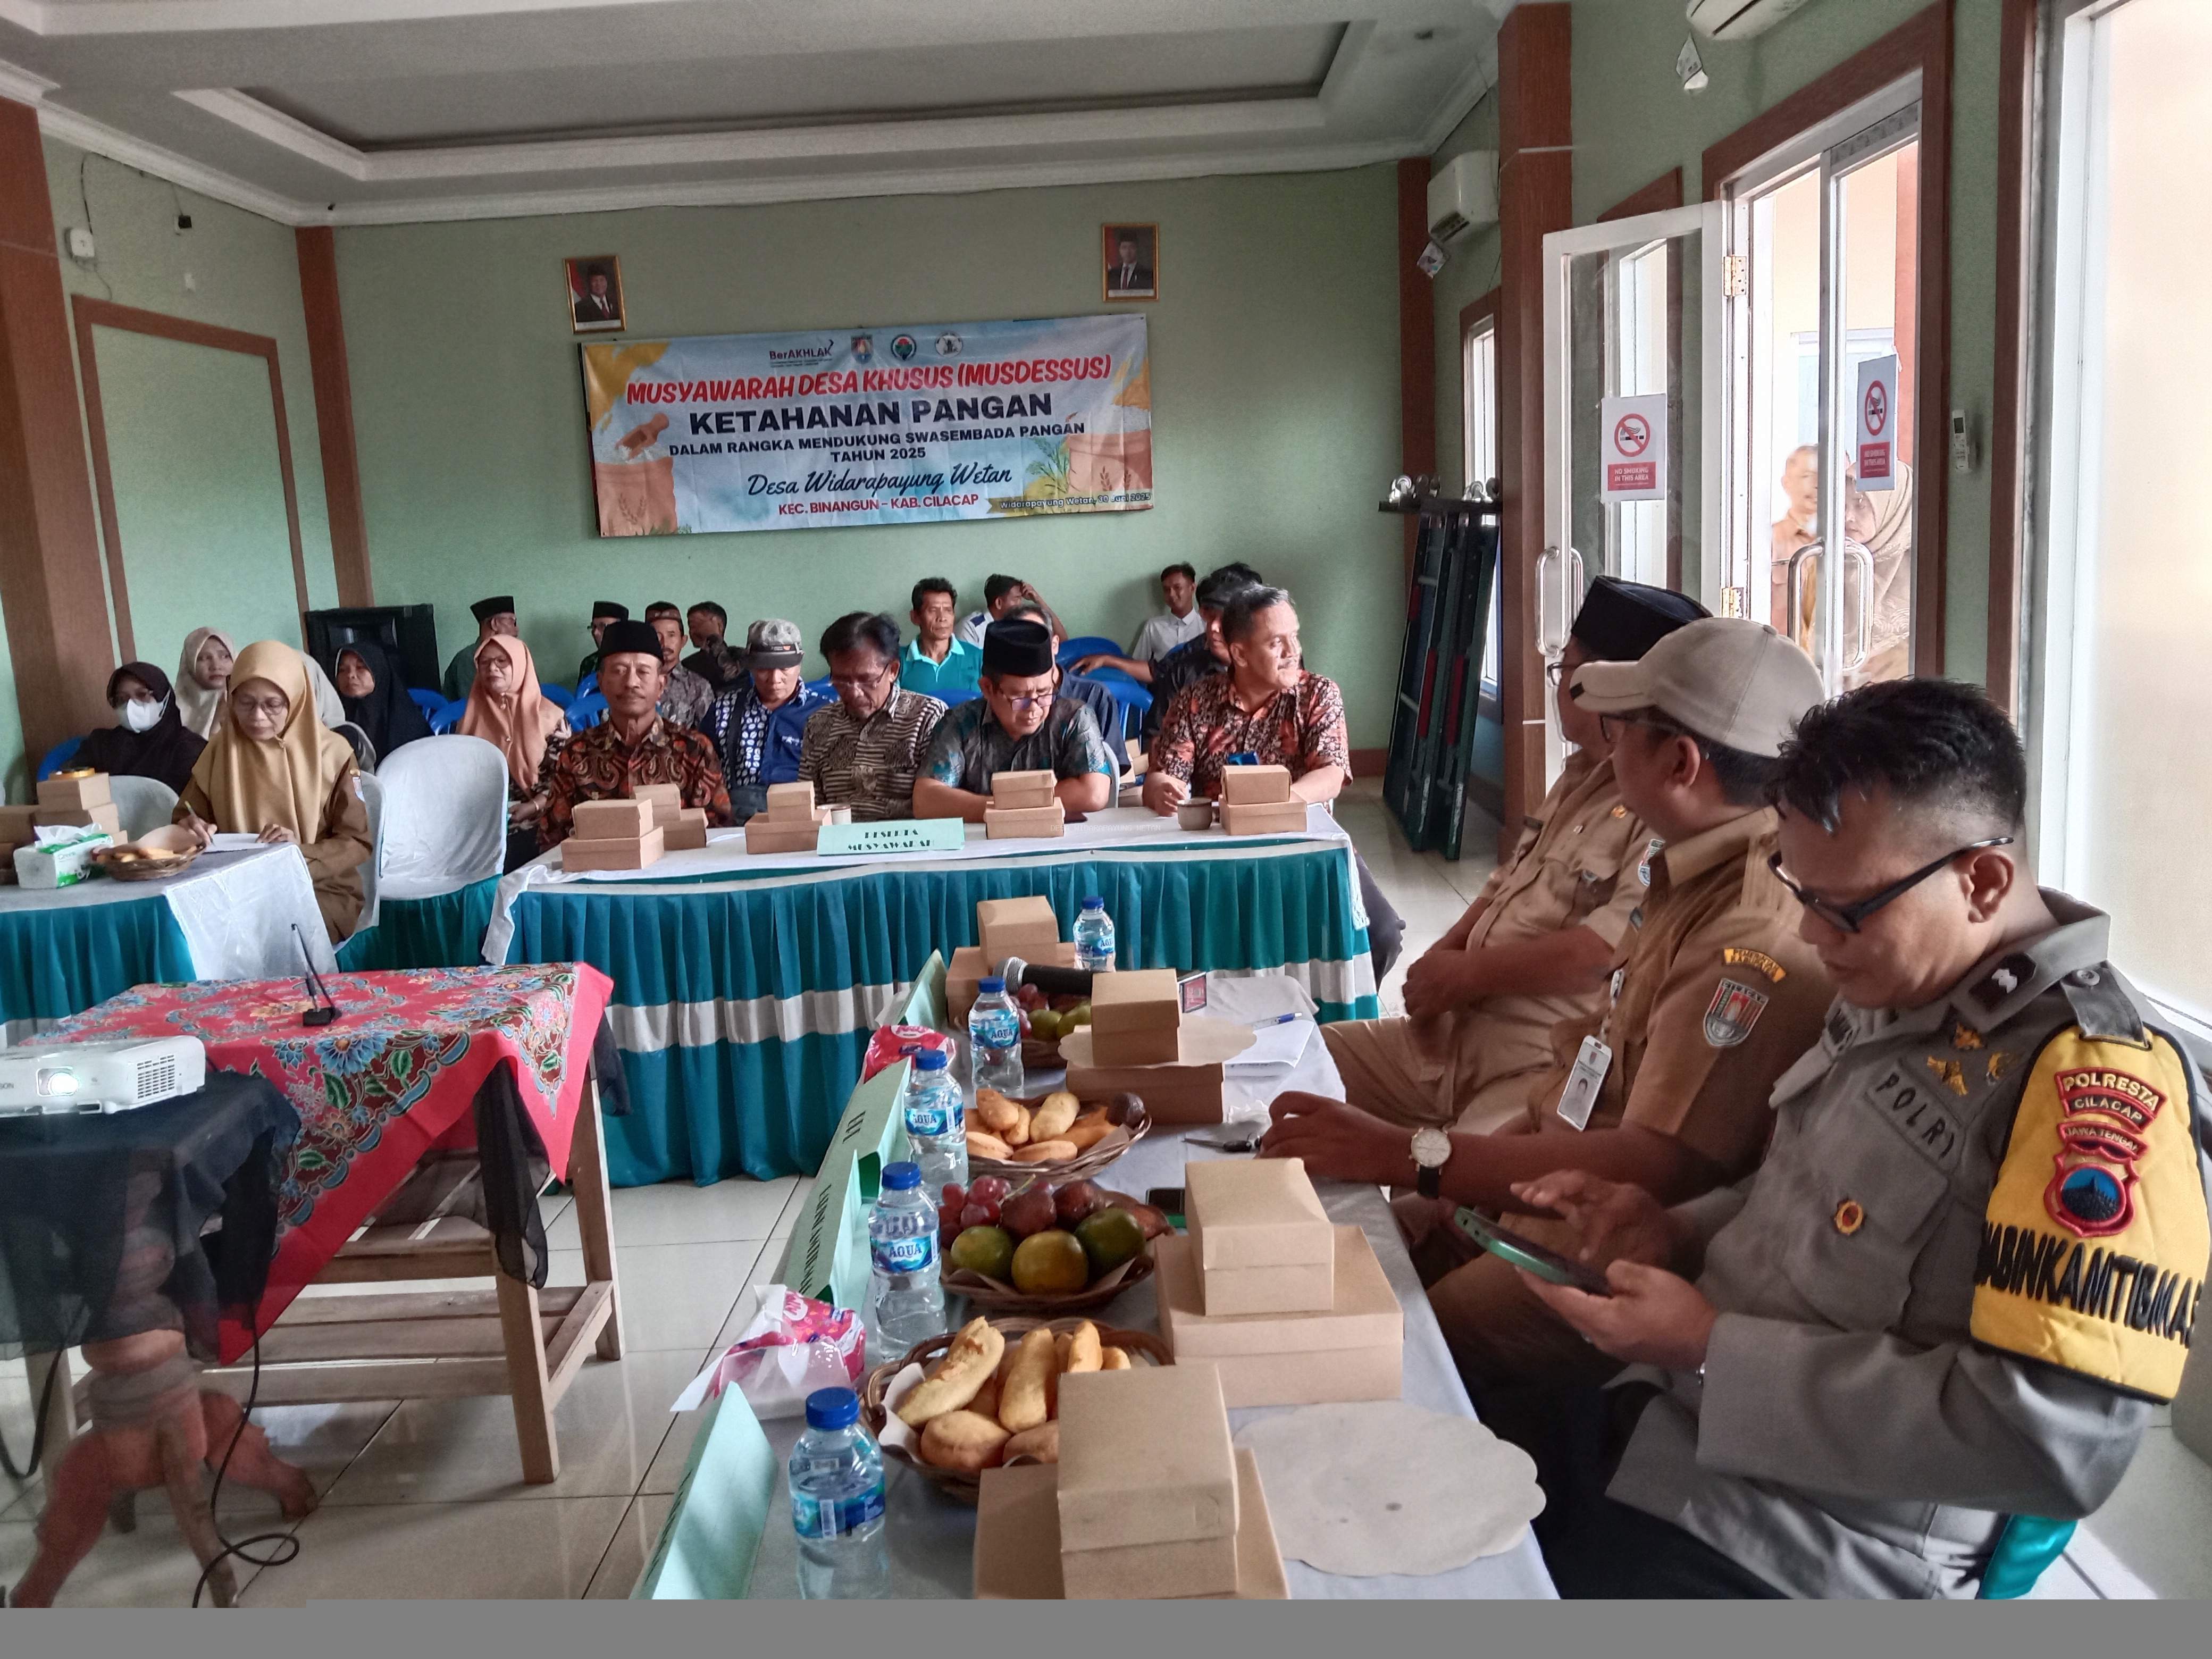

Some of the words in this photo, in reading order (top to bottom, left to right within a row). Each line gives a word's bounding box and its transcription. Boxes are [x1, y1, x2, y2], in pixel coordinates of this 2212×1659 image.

[769, 341, 833, 359] BerAKHLAK
[627, 375, 795, 404] MUSYAWARAH
[798, 370, 858, 396] DESA
[862, 366, 953, 392] KHUSUS
[957, 355, 1111, 387] (MUSDESSUS)
[689, 401, 901, 435] KETAHANAN
[911, 392, 1052, 423] PANGAN
[669, 442, 722, 456] DALAM
[727, 439, 794, 453] RANGKA
[799, 433, 901, 450] MENDUKUNG
[905, 426, 1015, 442] SWASEMBADA
[1020, 423, 1085, 437] PANGAN
[831, 450, 885, 463] TAHUN
[890, 447, 926, 460] 2025
[748, 474, 799, 496] Desa
[804, 468, 944, 497] Widarapayung
[950, 462, 1012, 485] Wetan
[778, 504, 808, 515] KEC.
[810, 499, 879, 514] BINANGUN
[891, 497, 921, 509] KAB.
[923, 494, 979, 507] CILACAP
[1130, 493, 1151, 501] 2025
[991, 1028, 1013, 1038] AQUA
[2062, 1073, 2159, 1111] POLRESTA
[2074, 1096, 2143, 1120] CILACAP
[2065, 1127, 2097, 1136] JAWA
[889, 1244, 922, 1258] AQUA
